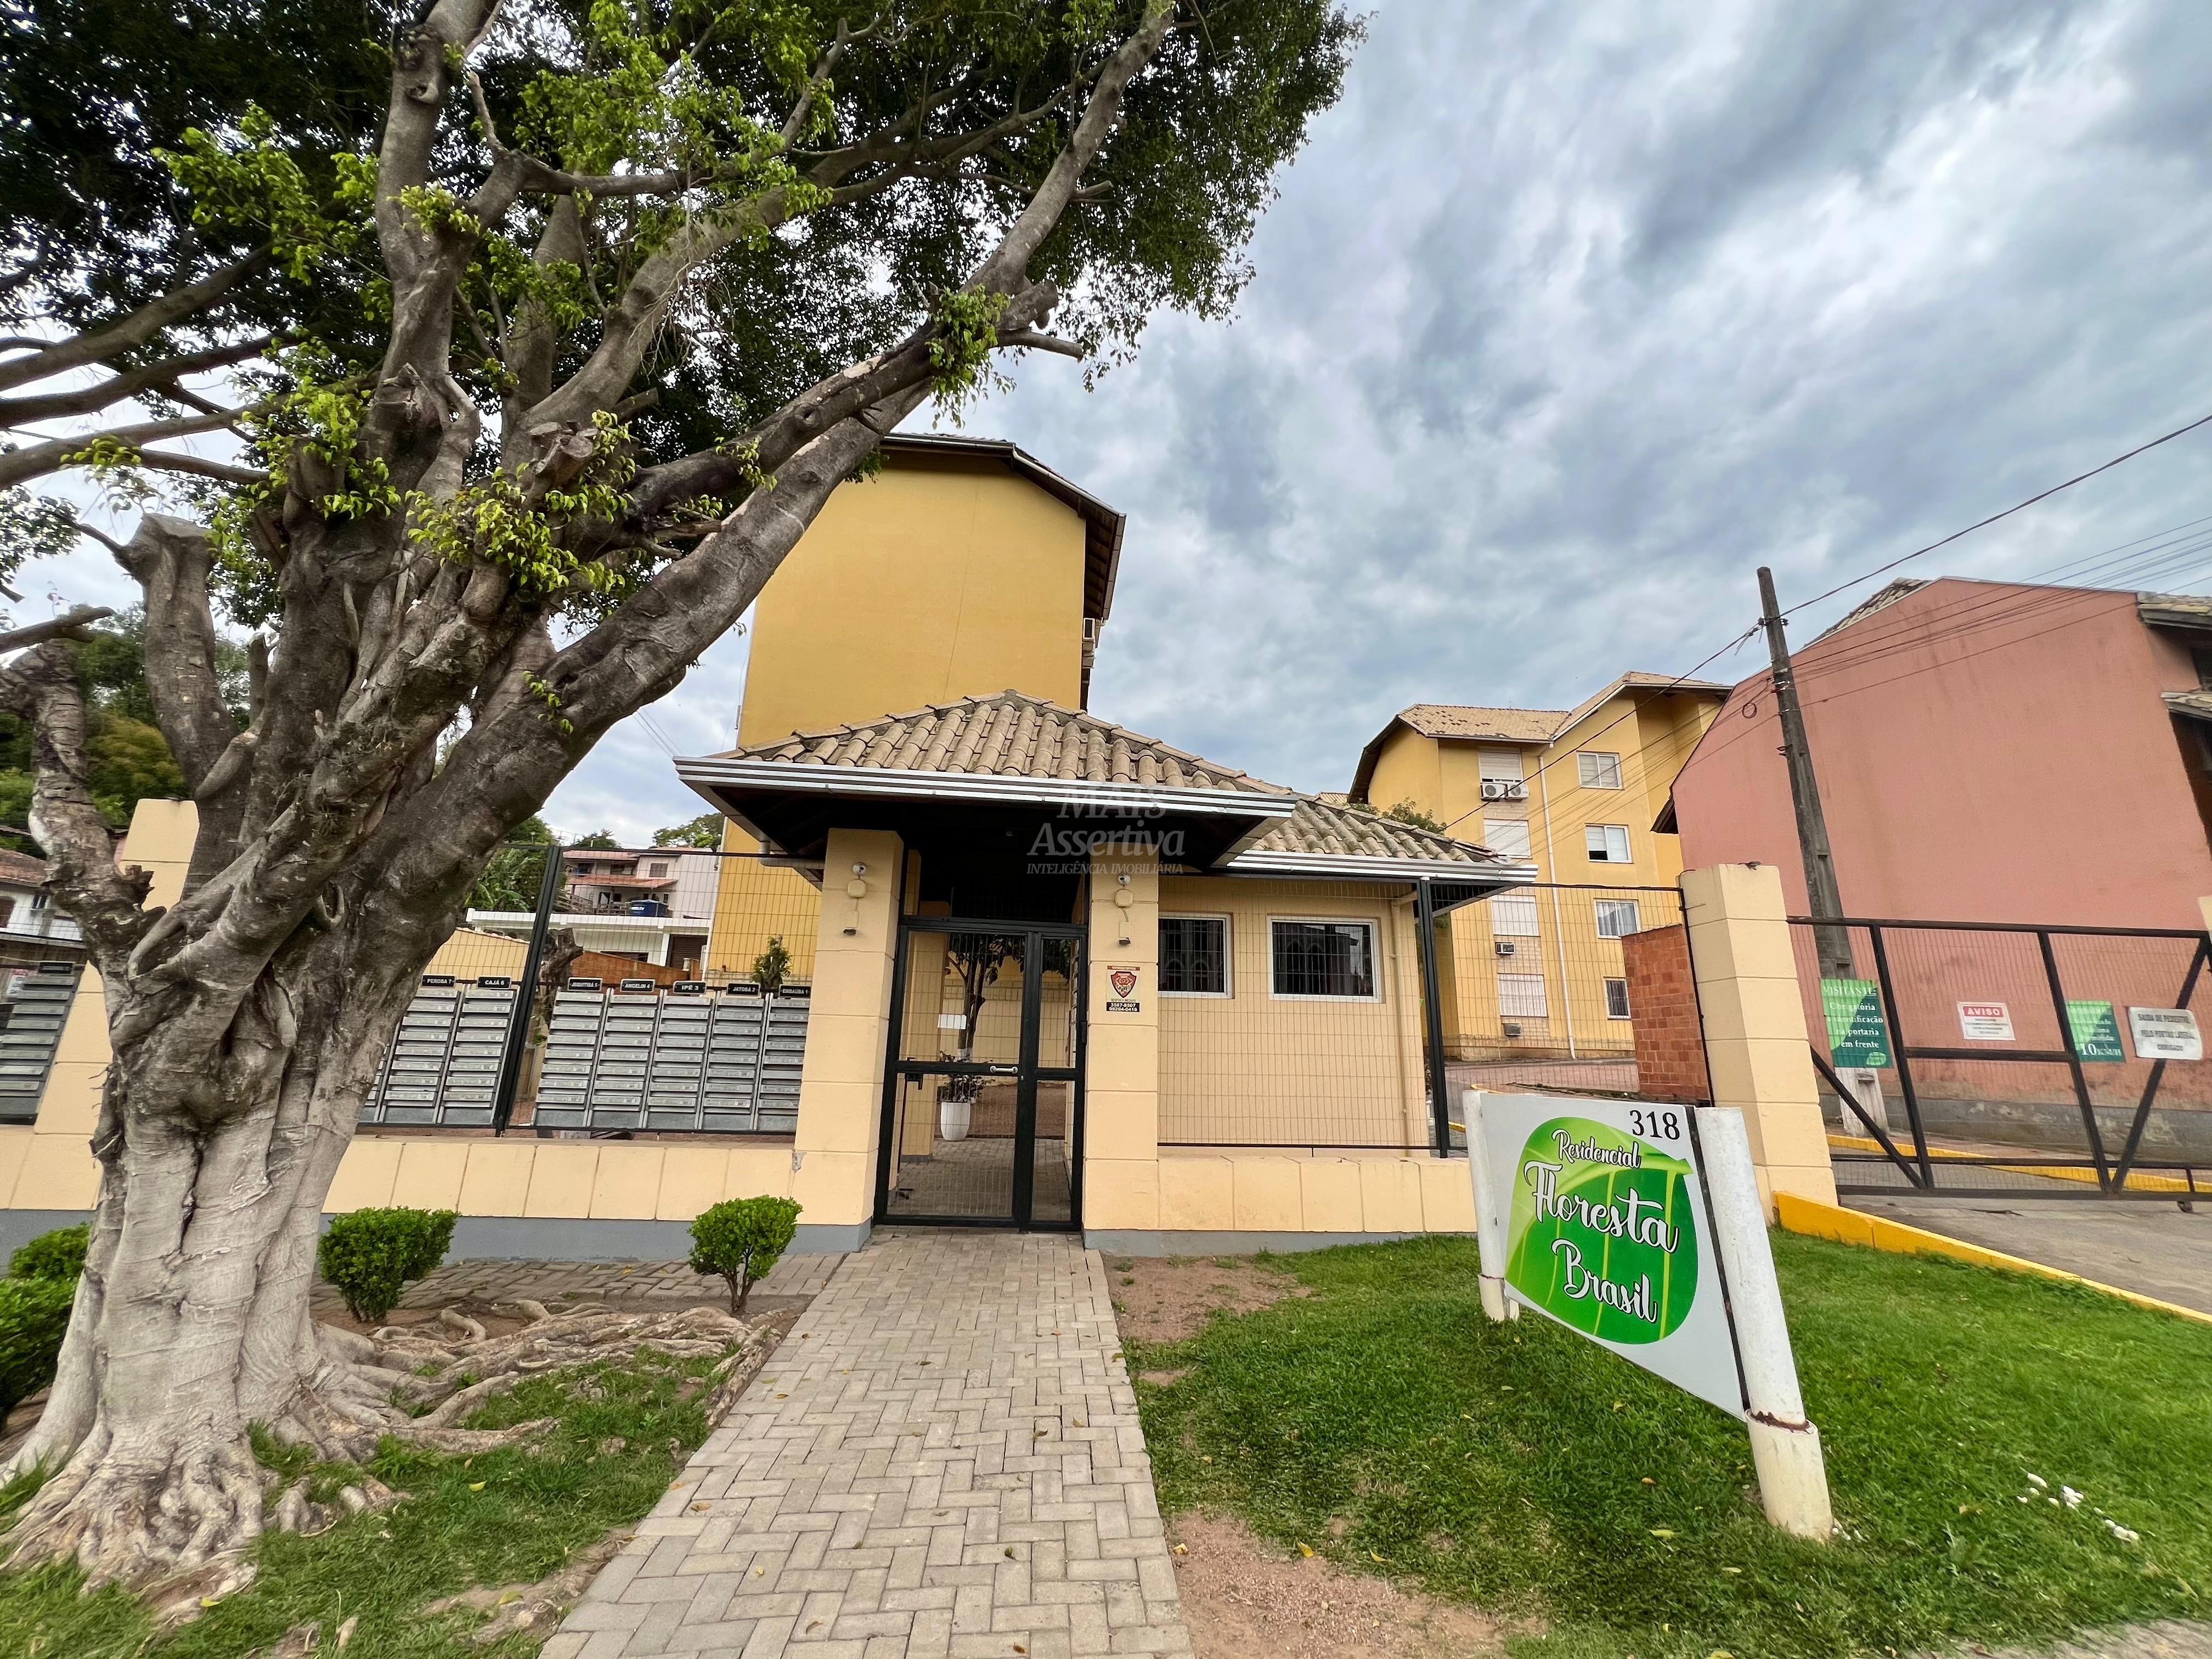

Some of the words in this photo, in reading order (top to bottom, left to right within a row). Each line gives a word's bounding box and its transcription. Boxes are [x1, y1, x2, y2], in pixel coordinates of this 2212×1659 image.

[1967, 1007, 2000, 1015] AVISO
[1848, 1028, 1879, 1037] portaria
[1629, 1110, 1680, 1140] 318
[1551, 1128, 1641, 1169] Residencial
[1523, 1160, 1680, 1254] Floresta
[1551, 1238, 1658, 1324] Brasil
